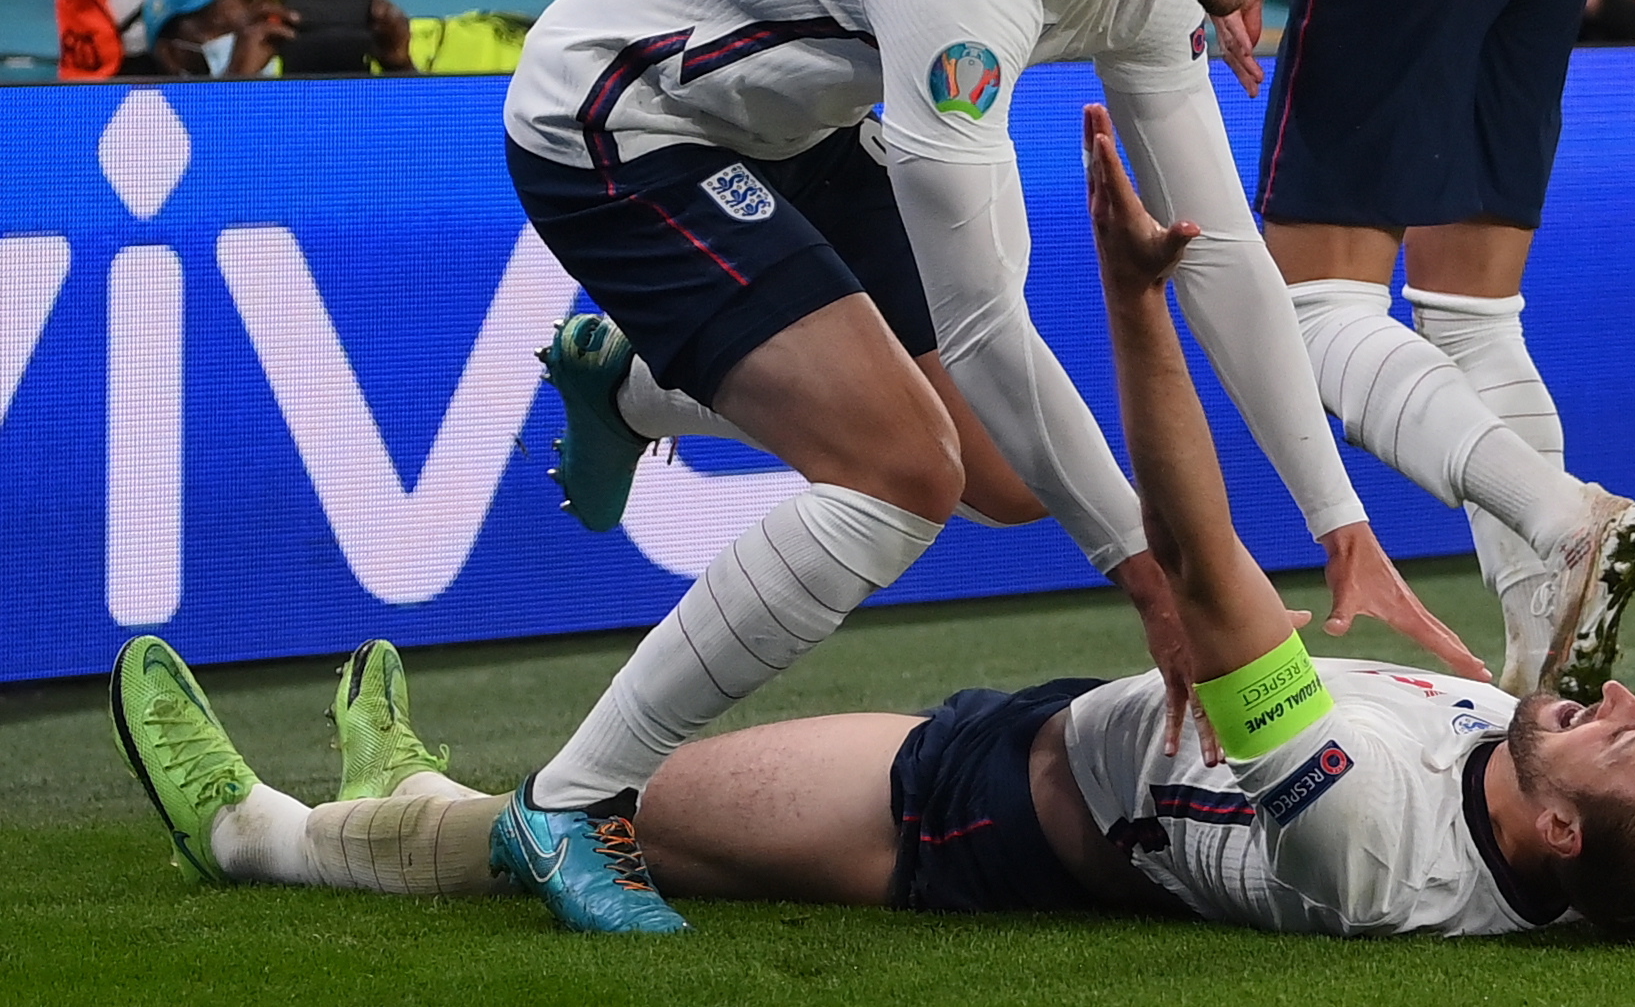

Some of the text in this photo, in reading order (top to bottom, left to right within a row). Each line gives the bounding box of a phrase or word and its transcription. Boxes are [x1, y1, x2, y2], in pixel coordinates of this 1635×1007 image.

[1241, 661, 1301, 707] RESPECT
[1243, 702, 1285, 735] GAME
[1268, 767, 1325, 819] RESPECT
